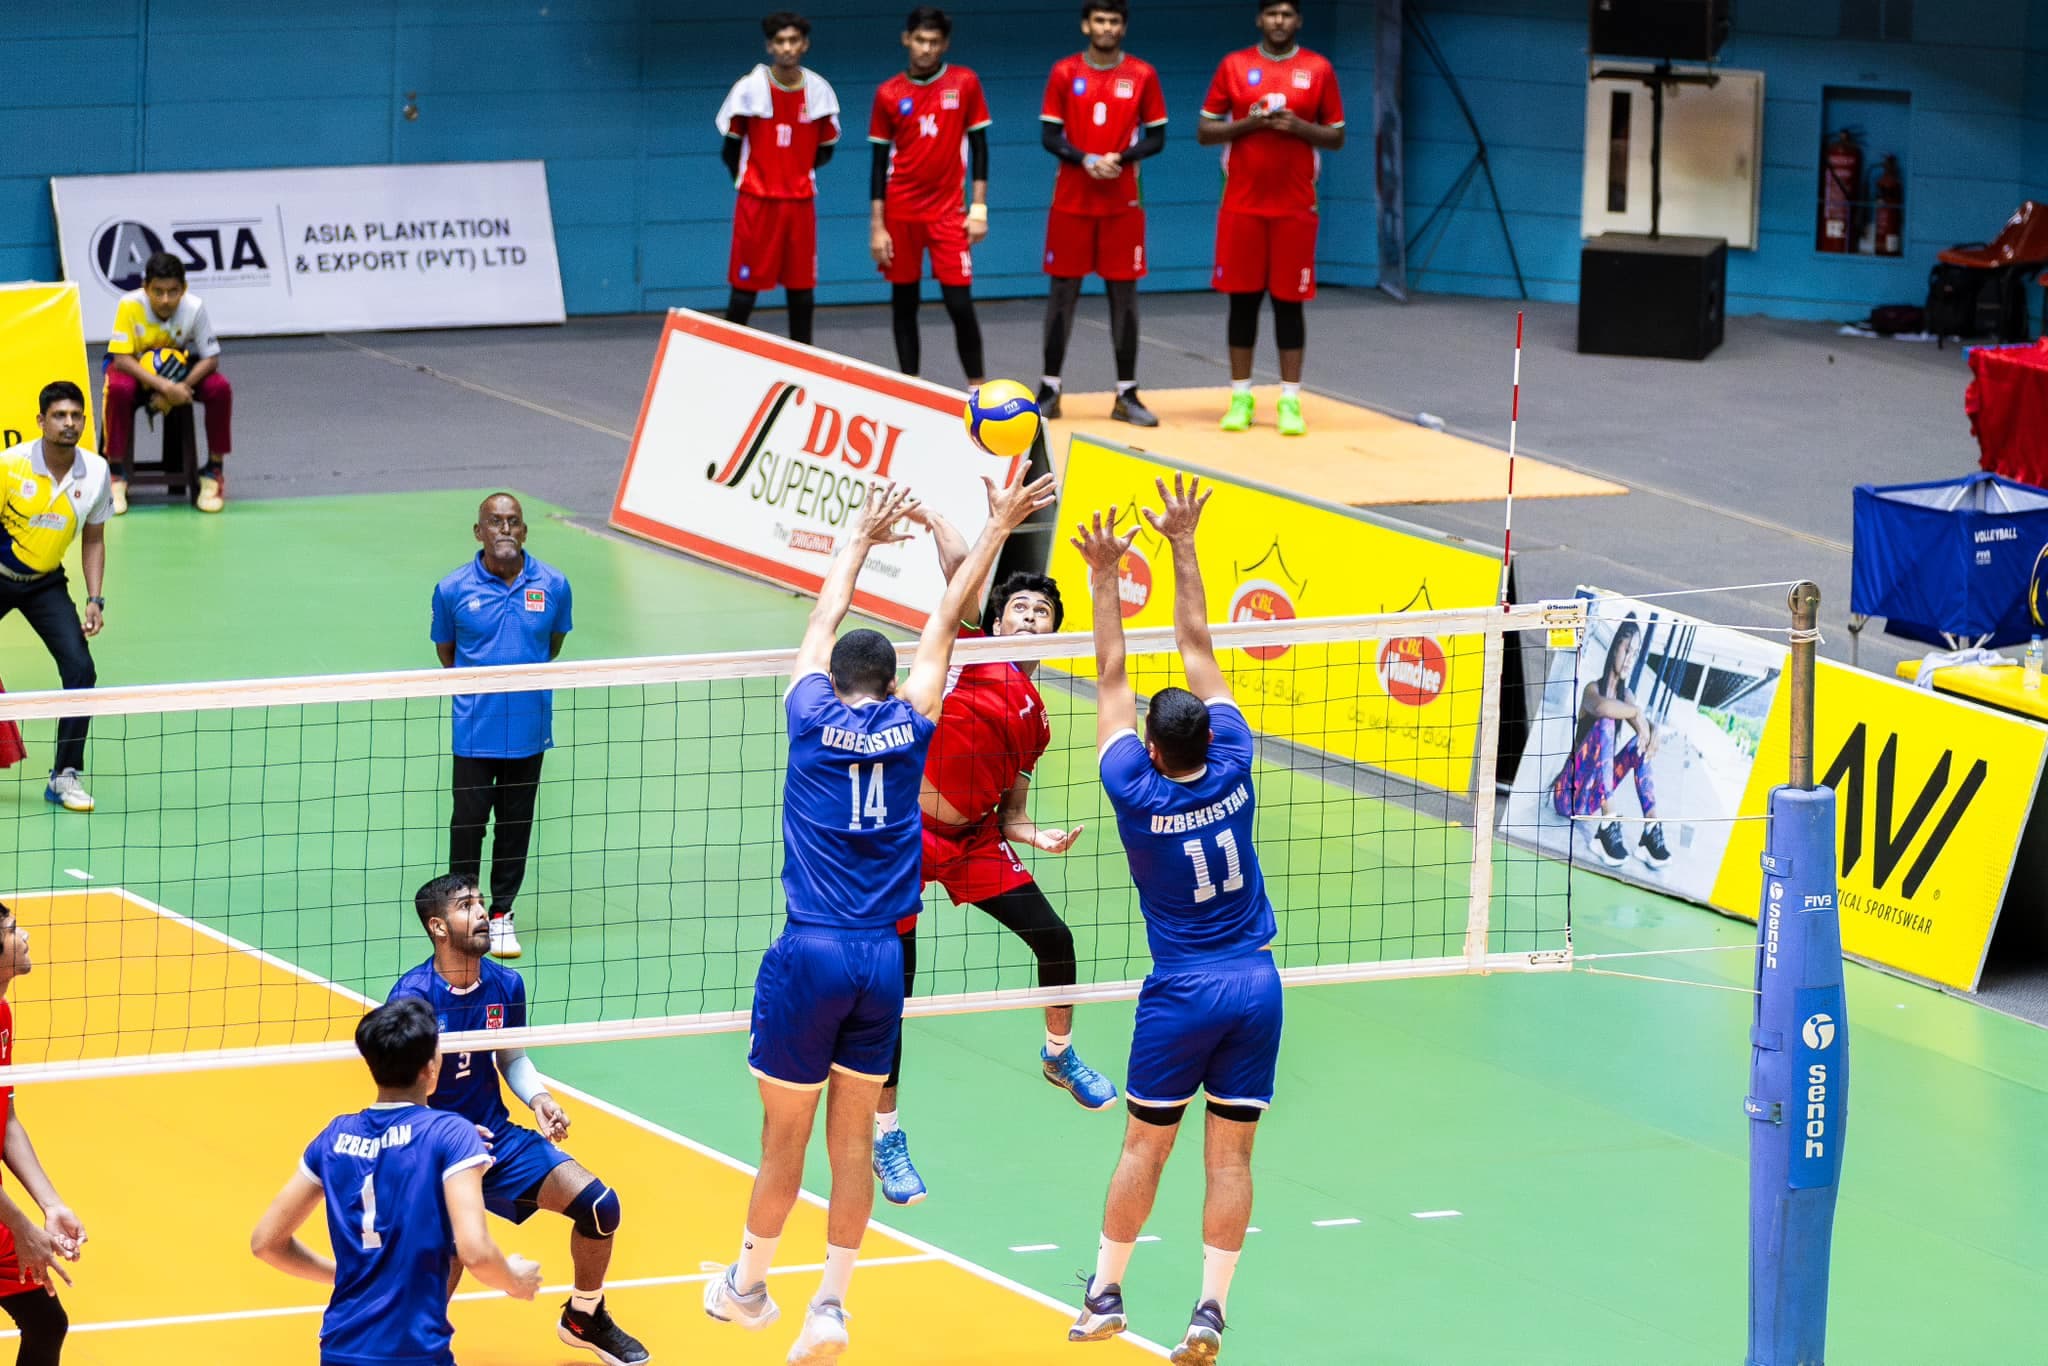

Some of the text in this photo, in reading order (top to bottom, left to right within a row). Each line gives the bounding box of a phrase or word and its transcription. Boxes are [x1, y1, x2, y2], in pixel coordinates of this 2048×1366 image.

[304, 218, 511, 244] ASIA PLANTATION
[296, 246, 528, 273] & EXPORT (PVT) LTD
[802, 402, 904, 478] DSI
[751, 450, 918, 549] SUPERSP
[1974, 527, 2018, 543] VOLLEYBALL
[1251, 592, 1275, 615] CBL
[1398, 638, 1424, 658] CBL
[821, 723, 915, 754] UZBEISTAN
[848, 762, 888, 831] 14
[1150, 783, 1249, 834] UZBEKISTAN
[1183, 828, 1244, 903] 11
[1864, 899, 1933, 935] SPORTSWEAR
[361, 1173, 382, 1249] 1
